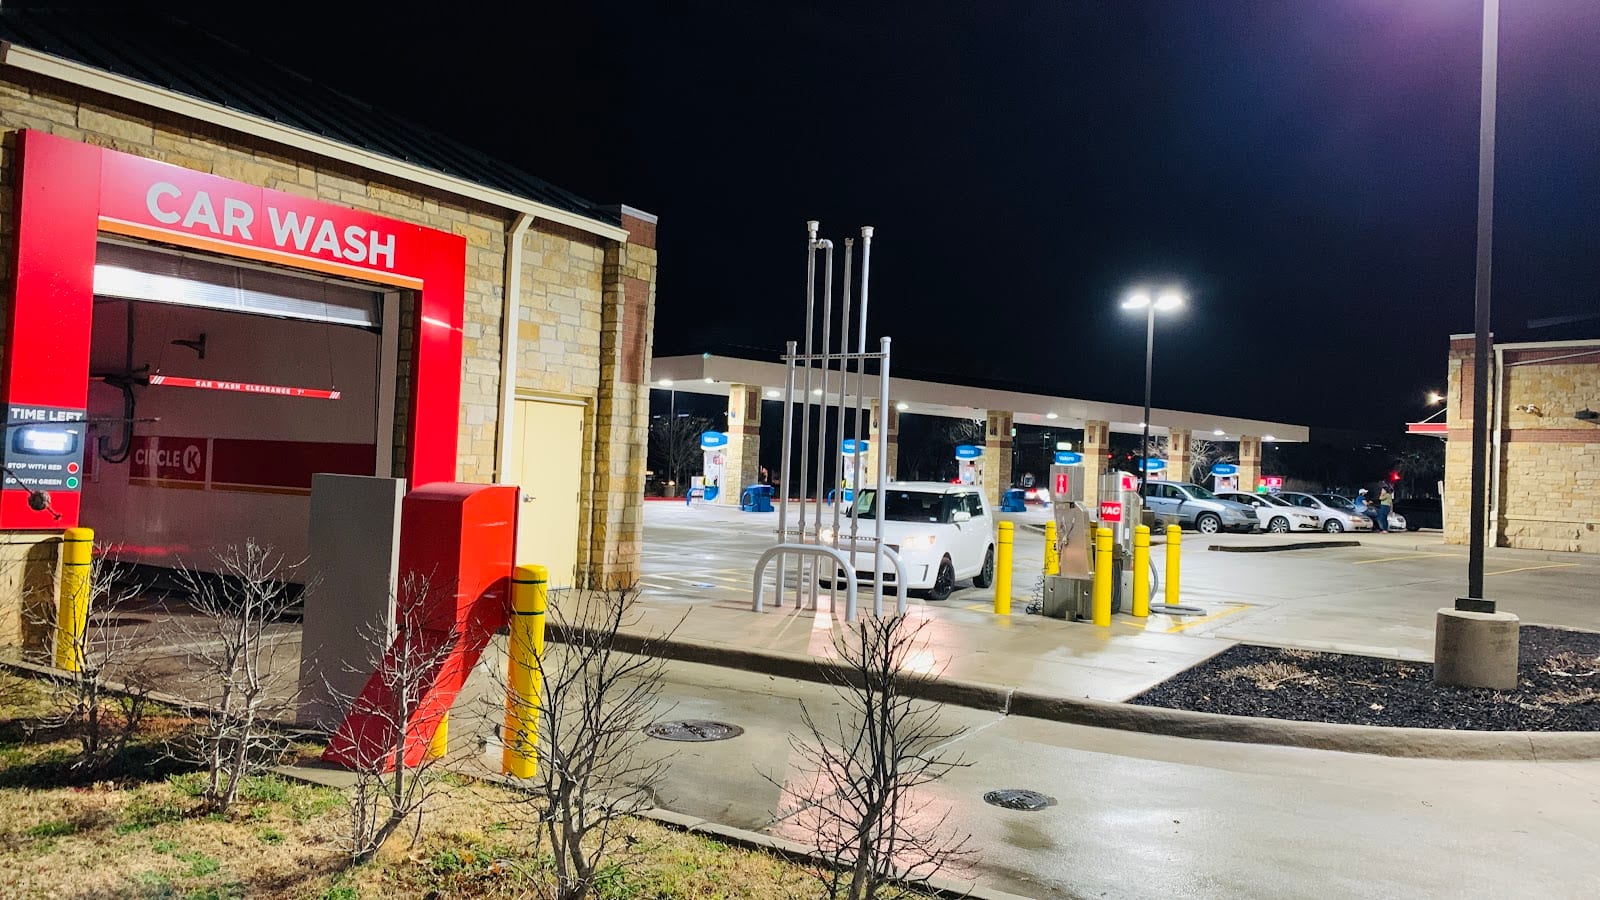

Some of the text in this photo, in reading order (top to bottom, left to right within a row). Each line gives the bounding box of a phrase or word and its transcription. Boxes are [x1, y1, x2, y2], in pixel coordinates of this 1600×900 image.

[146, 182, 396, 269] CAR WASH
[195, 380, 212, 389] CAR
[217, 381, 240, 391] WASH
[245, 383, 291, 395] CLEARANCE
[11, 408, 83, 421] TIME LEFT
[135, 448, 200, 474] CIRCLE K
[1101, 506, 1120, 515] VAC
